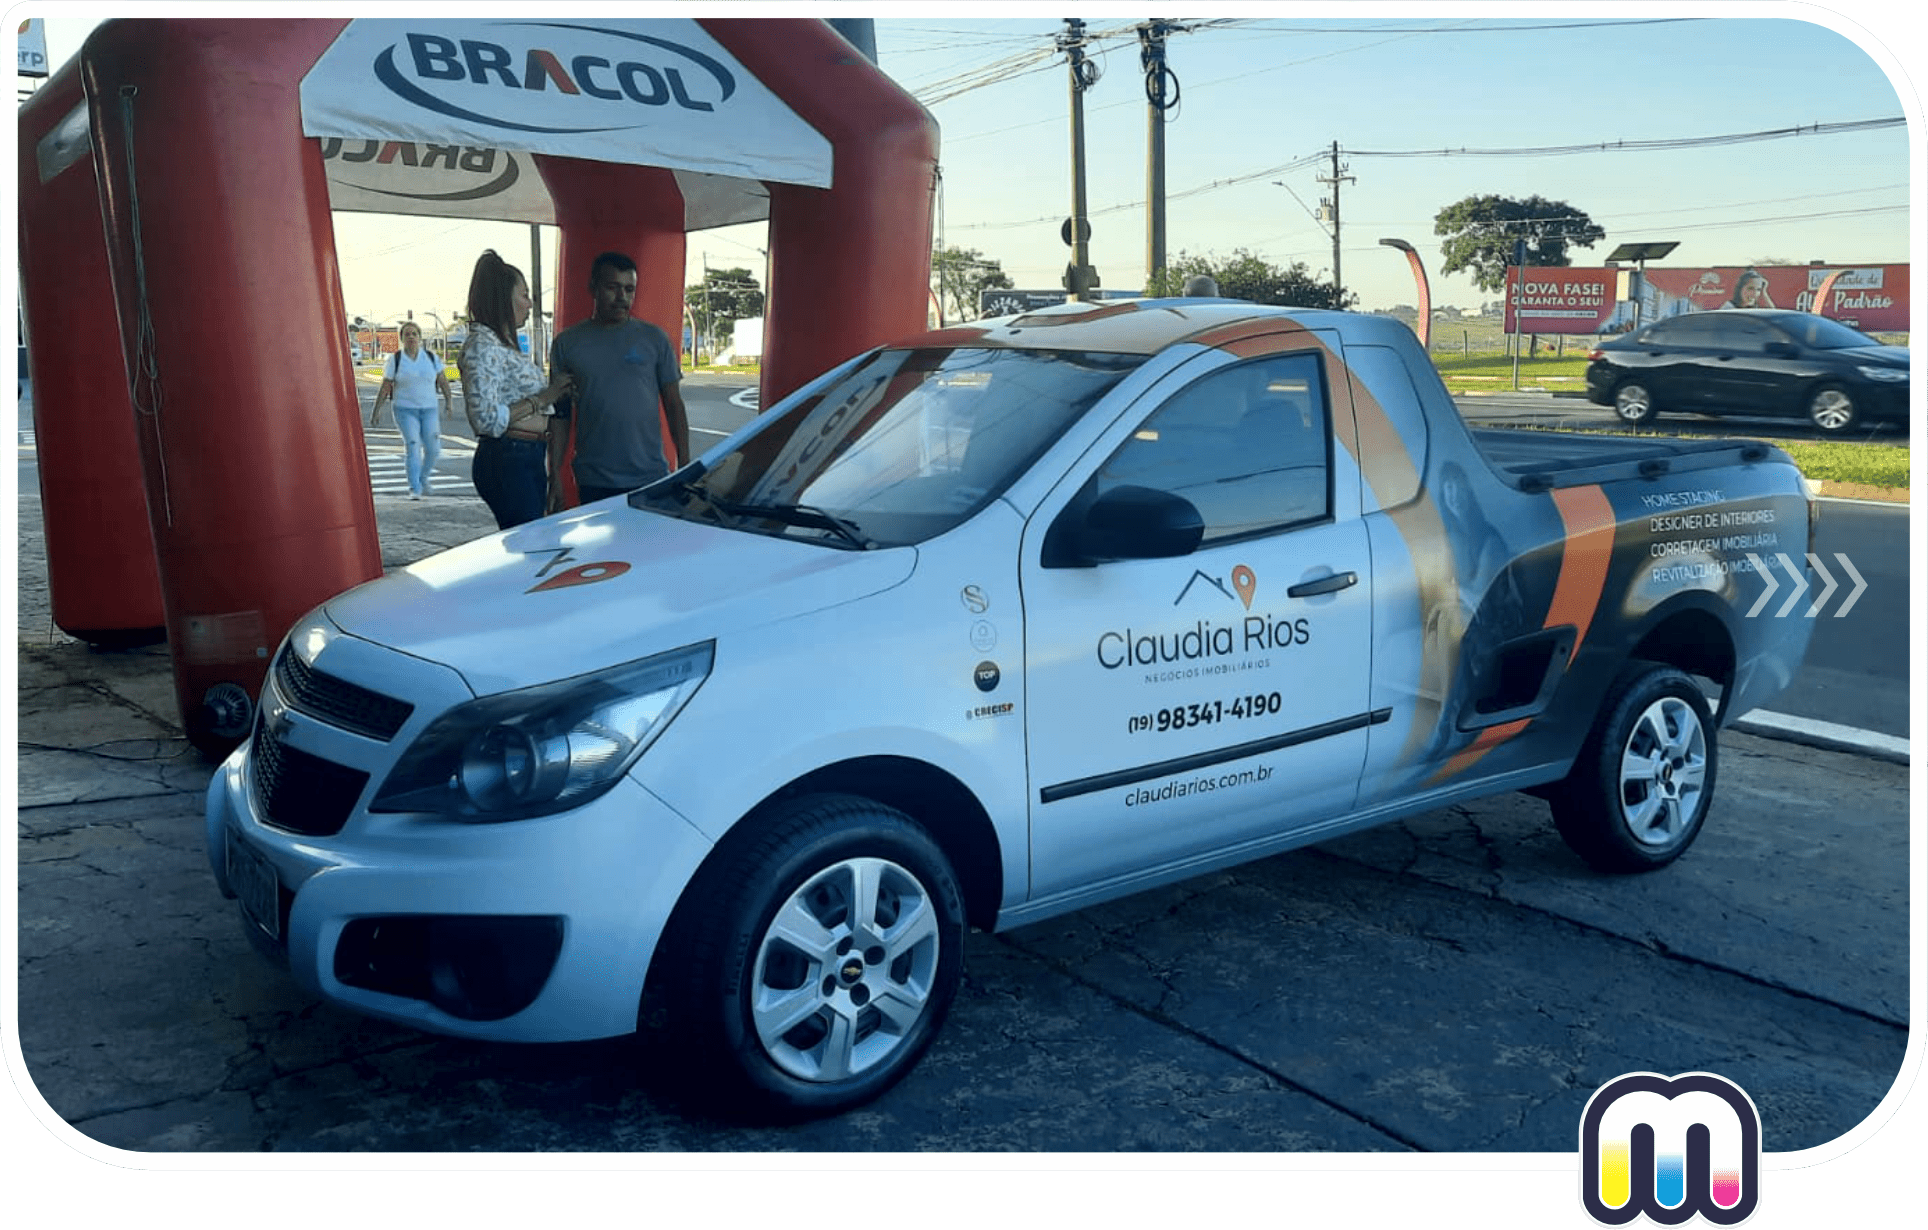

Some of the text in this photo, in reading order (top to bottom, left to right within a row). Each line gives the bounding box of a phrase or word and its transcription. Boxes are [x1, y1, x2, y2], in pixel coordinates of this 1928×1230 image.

[406, 32, 714, 112] BRACOL
[1511, 282, 1604, 296] NOVA FASE!
[1510, 296, 1564, 307] GARANTA
[1567, 297, 1577, 306] O
[1795, 290, 1890, 314] Al Padrão
[1650, 510, 1775, 532] DESIGNER DE INTERIORES
[1650, 538, 1720, 557] CORRETAGEM
[1097, 613, 1310, 670] Claudia Rios
[977, 670, 996, 681] TOP
[1128, 691, 1282, 734] (19) 98341-4190
[1125, 765, 1274, 807] claudiarios.com.br
